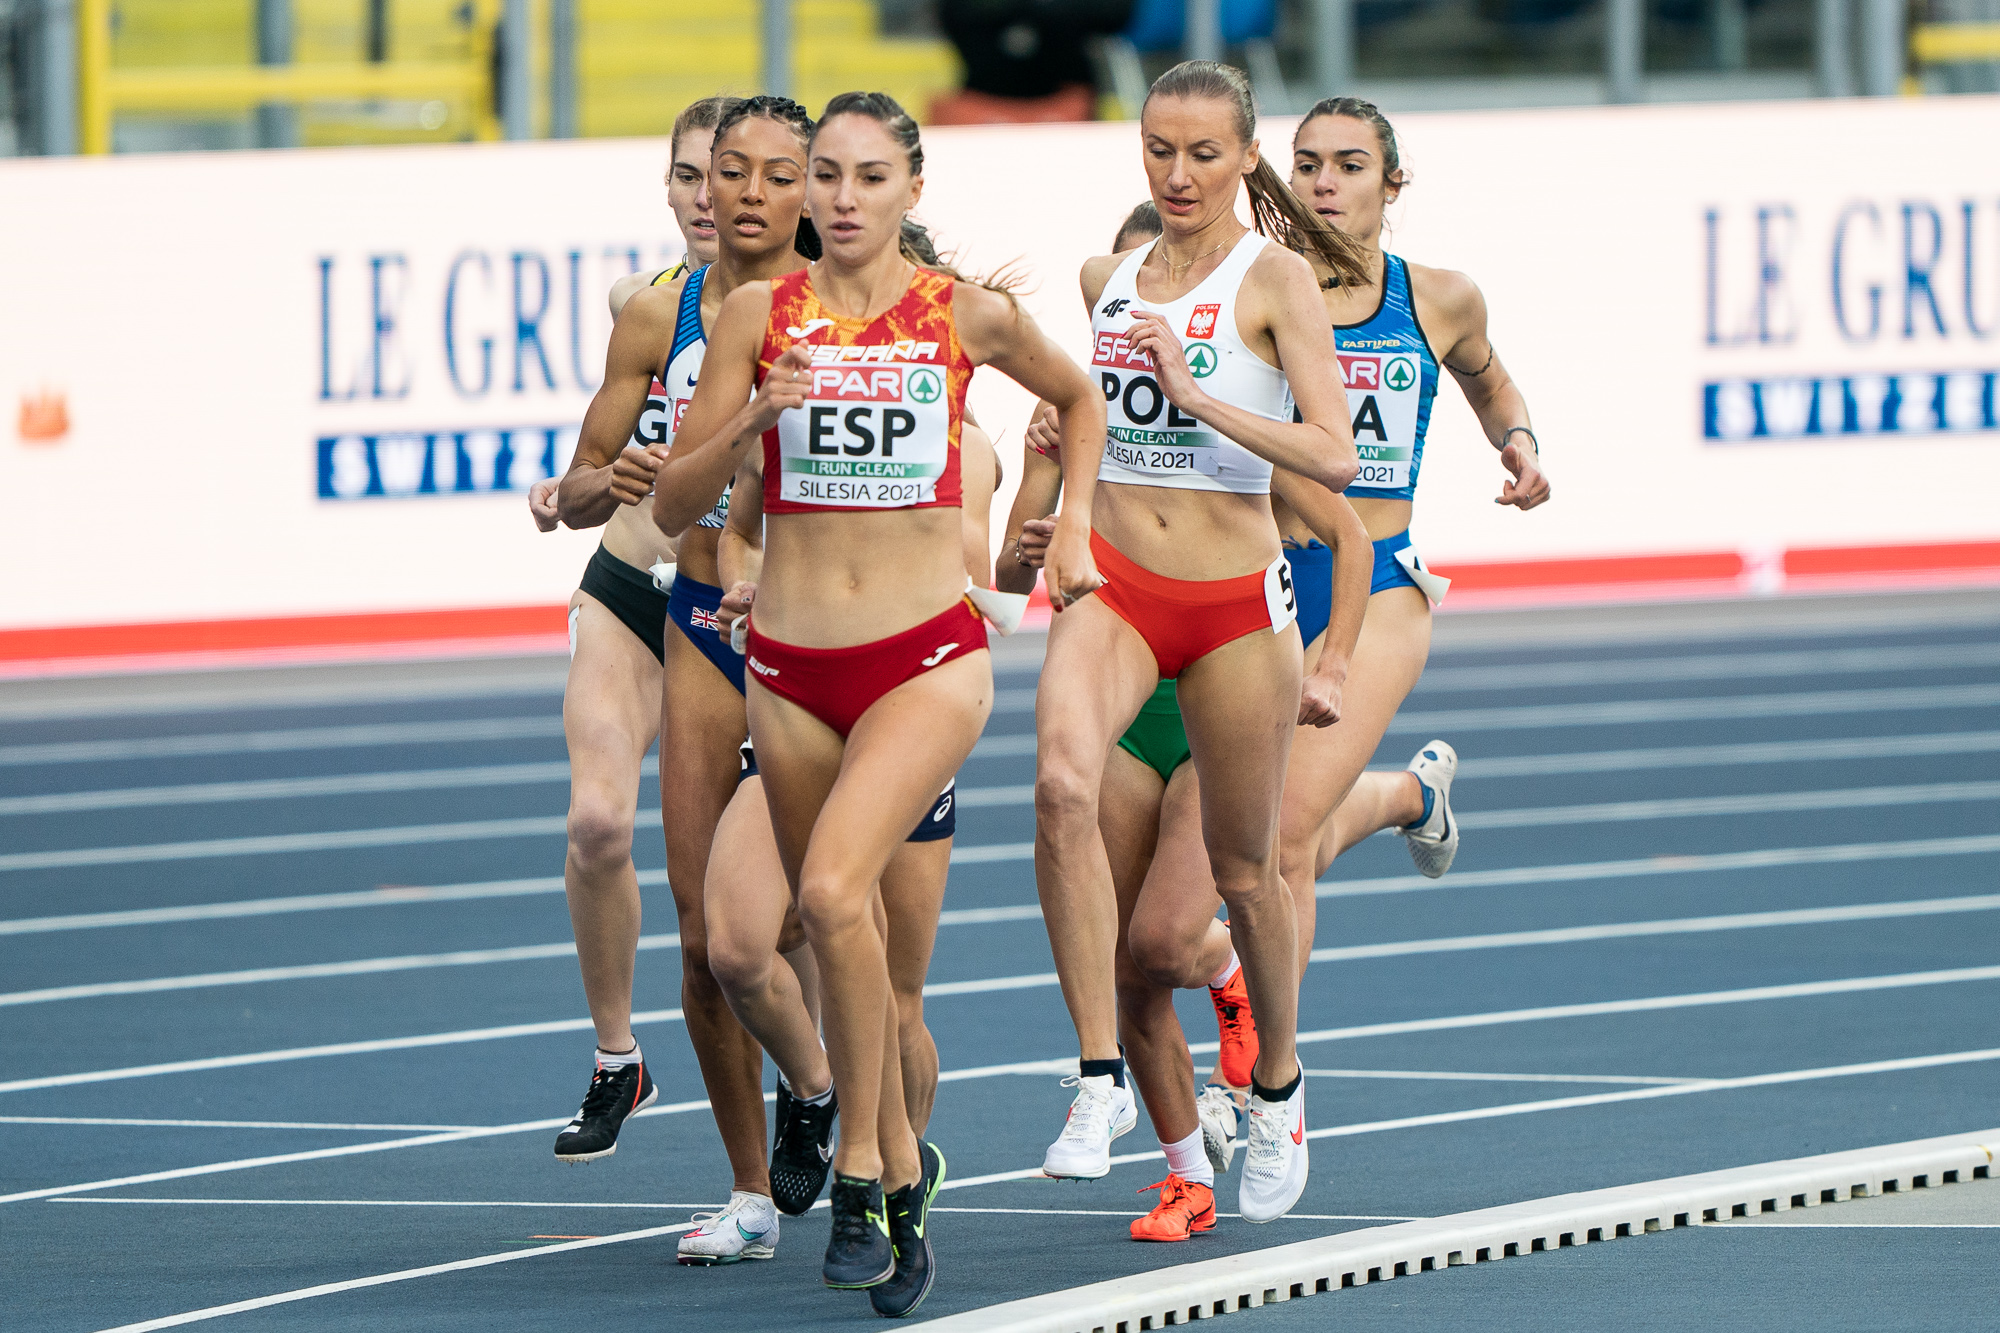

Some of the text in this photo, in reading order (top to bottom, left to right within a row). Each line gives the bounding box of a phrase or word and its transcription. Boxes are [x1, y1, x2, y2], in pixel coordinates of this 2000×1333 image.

[1703, 204, 1796, 346] LE
[317, 252, 411, 404] LE
[1342, 339, 1401, 349] FASTWEB
[1095, 335, 1155, 367] SPA
[810, 369, 900, 398] PAR
[1102, 372, 1197, 428] POL
[809, 406, 916, 457] ESP
[818, 461, 852, 475] RUN
[1106, 440, 1194, 469] SILESIA 2021
[799, 480, 921, 501] SILESIA 2021
[1277, 563, 1295, 612] 5
